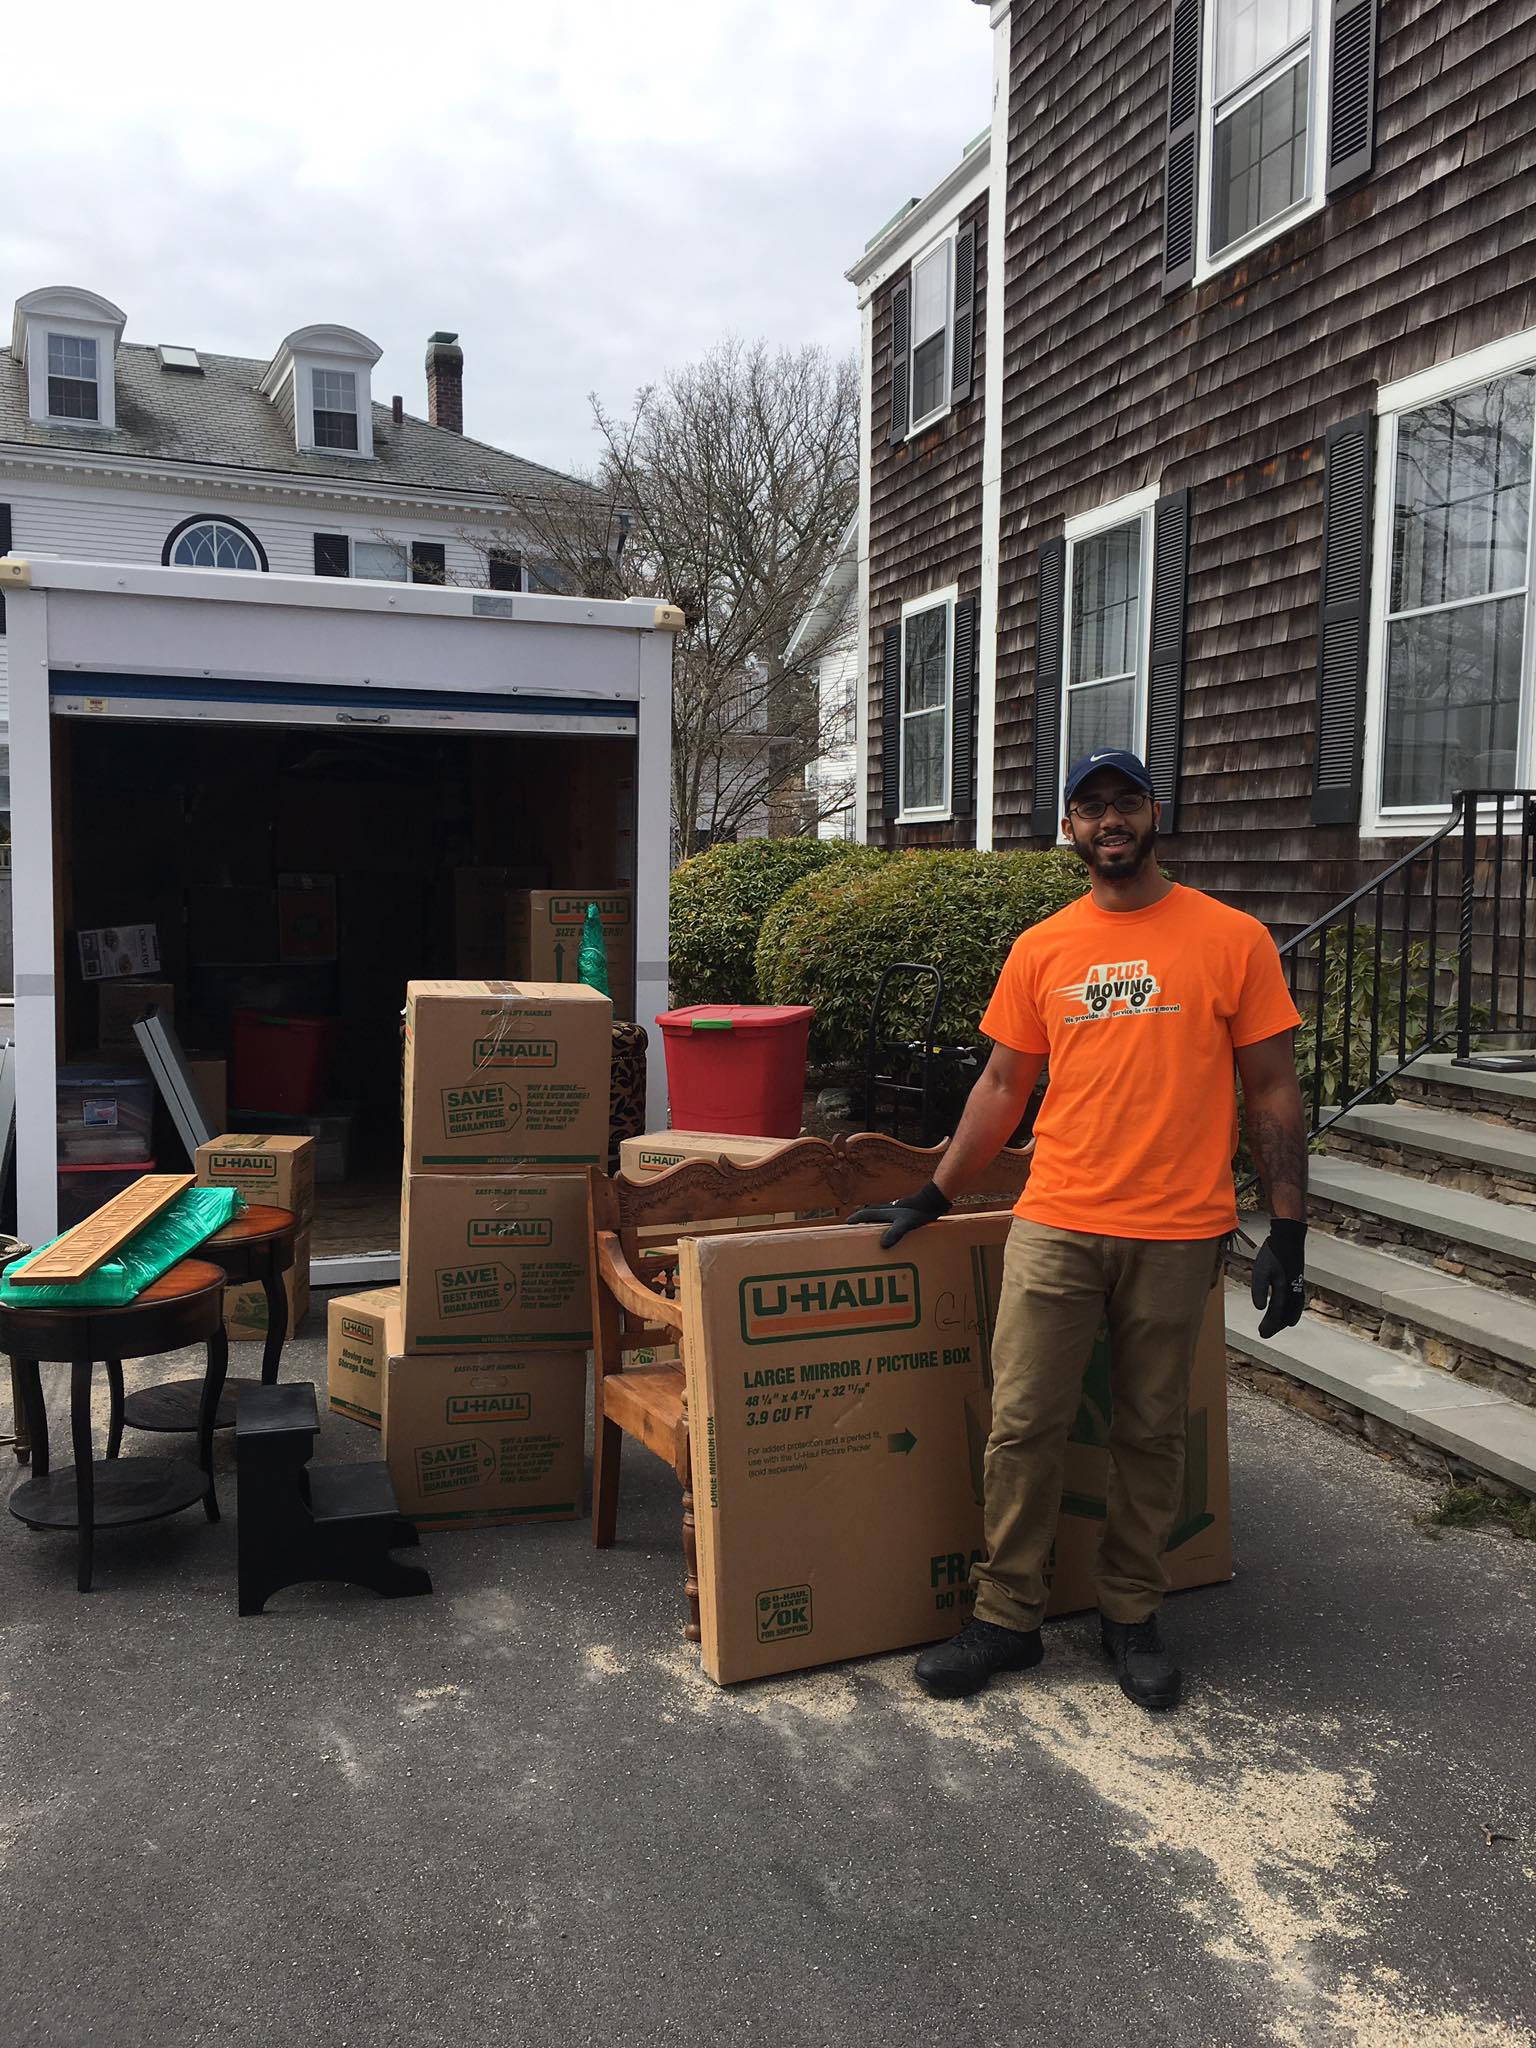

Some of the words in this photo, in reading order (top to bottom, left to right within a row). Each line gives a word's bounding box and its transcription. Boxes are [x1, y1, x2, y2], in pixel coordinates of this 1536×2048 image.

[555, 927, 576, 937] SIZE
[1089, 969, 1099, 983] A
[1106, 963, 1145, 980] PLUS
[1085, 978, 1153, 1000] MOVING
[1075, 1013, 1099, 1022] provide
[478, 1043, 553, 1057] U-HAUL
[447, 1087, 504, 1108] SAVE!
[449, 1111, 474, 1124] BEST
[475, 1108, 504, 1121] PRICE
[213, 1157, 273, 1168] U-HAUL
[473, 1223, 547, 1236] U-HAUL
[441, 1268, 498, 1288] SAVE!
[442, 1291, 468, 1304] BEST
[470, 1288, 499, 1301] PRICE
[752, 1275, 909, 1317] U-HAUL
[343, 1321, 372, 1337] U-HAUL
[338, 1358, 360, 1373] Storage
[342, 1348, 362, 1364] Moving
[362, 1356, 374, 1366] and
[743, 1367, 796, 1388] LARGE
[800, 1359, 861, 1381] MIRROR
[865, 1358, 872, 1375] /
[877, 1351, 938, 1374] PICTURE
[942, 1347, 971, 1364] BOX
[452, 1397, 526, 1413] U-HAUL
[745, 1395, 759, 1407] 48
[832, 1385, 846, 1397] 32
[746, 1410, 769, 1426] 3.9
[772, 1407, 791, 1423] CU
[794, 1405, 813, 1420] FT
[706, 1416, 715, 1435] BOX
[747, 1447, 760, 1456] For
[763, 1443, 786, 1454] added
[787, 1438, 823, 1451] protection
[825, 1436, 838, 1445] and
[846, 1432, 872, 1445] perfect
[420, 1443, 478, 1466] SAVE!
[748, 1458, 761, 1466] use
[763, 1454, 779, 1464] with
[780, 1453, 792, 1462] the
[793, 1450, 819, 1461] U-Haul
[821, 1446, 847, 1457] Picture
[847, 1443, 871, 1453] Packer
[422, 1469, 446, 1482] BEST
[448, 1464, 479, 1477] PRICE
[772, 1590, 809, 1602] U-HAUL
[935, 1591, 955, 1610] DO
[777, 1606, 809, 1626] OK
[761, 1630, 775, 1639] FOR
